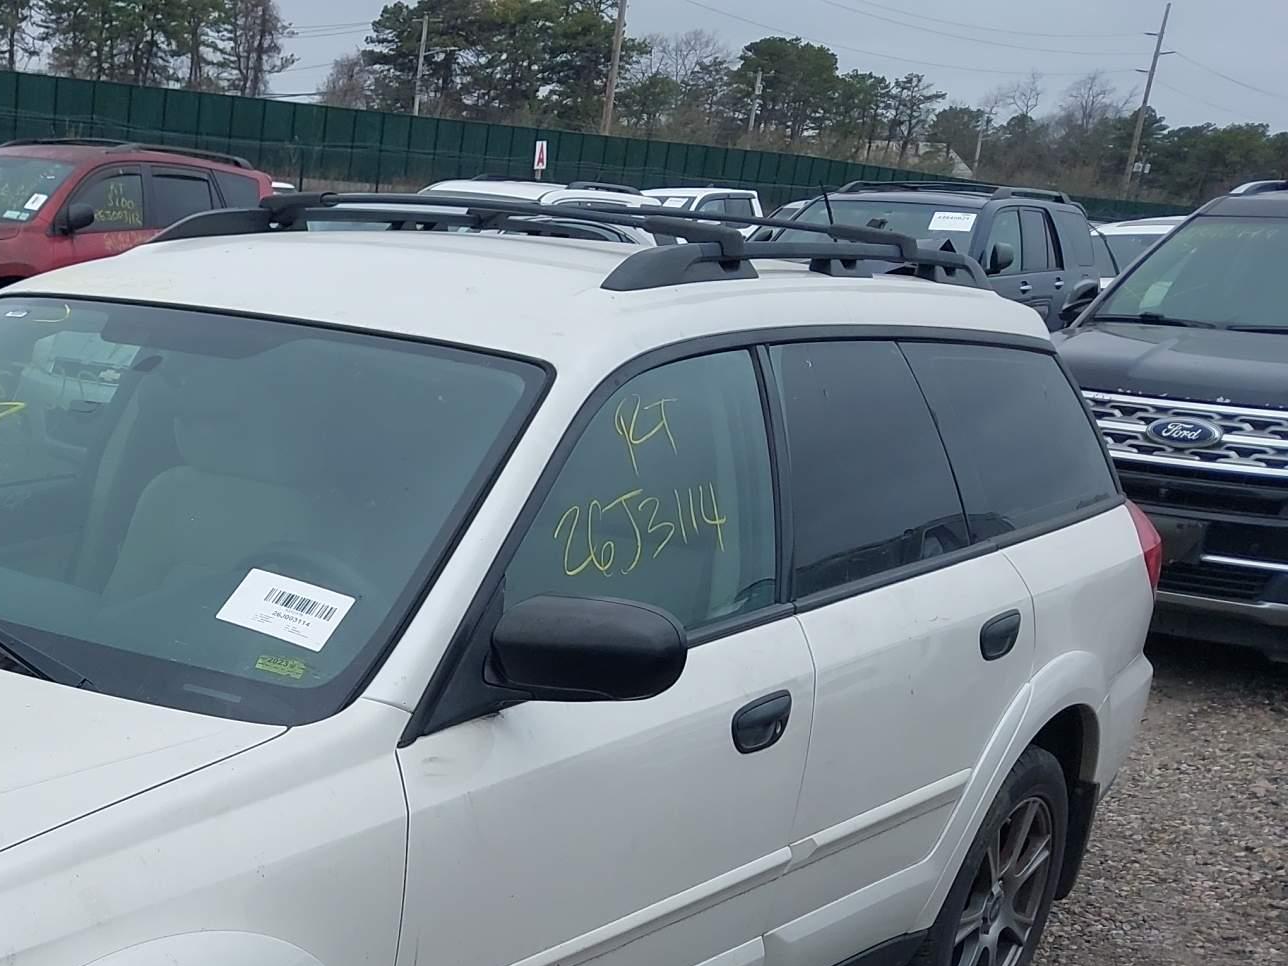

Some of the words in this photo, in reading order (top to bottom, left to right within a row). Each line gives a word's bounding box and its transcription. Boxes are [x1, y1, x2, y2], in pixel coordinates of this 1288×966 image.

[537, 141, 545, 167] A
[1161, 422, 1202, 440] Ford
[553, 480, 727, 577] 26J3114
